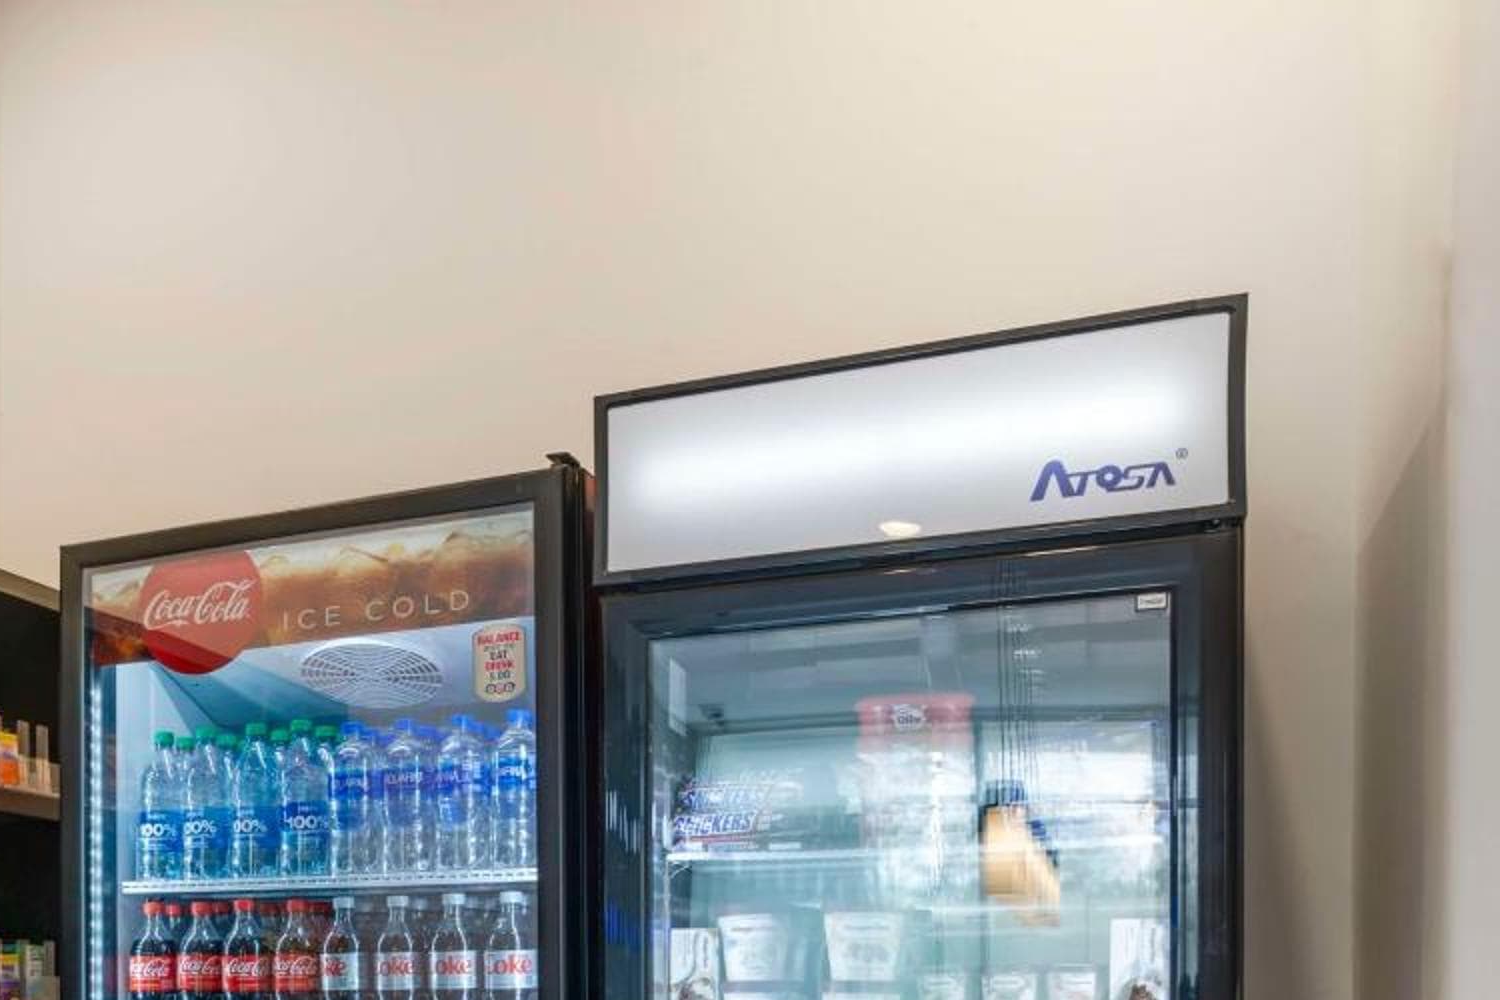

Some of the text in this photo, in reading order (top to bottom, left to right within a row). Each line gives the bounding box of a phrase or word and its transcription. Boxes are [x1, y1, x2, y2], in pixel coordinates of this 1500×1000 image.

[144, 578, 257, 629] Coca-Cola
[281, 589, 470, 631] ICE COLD
